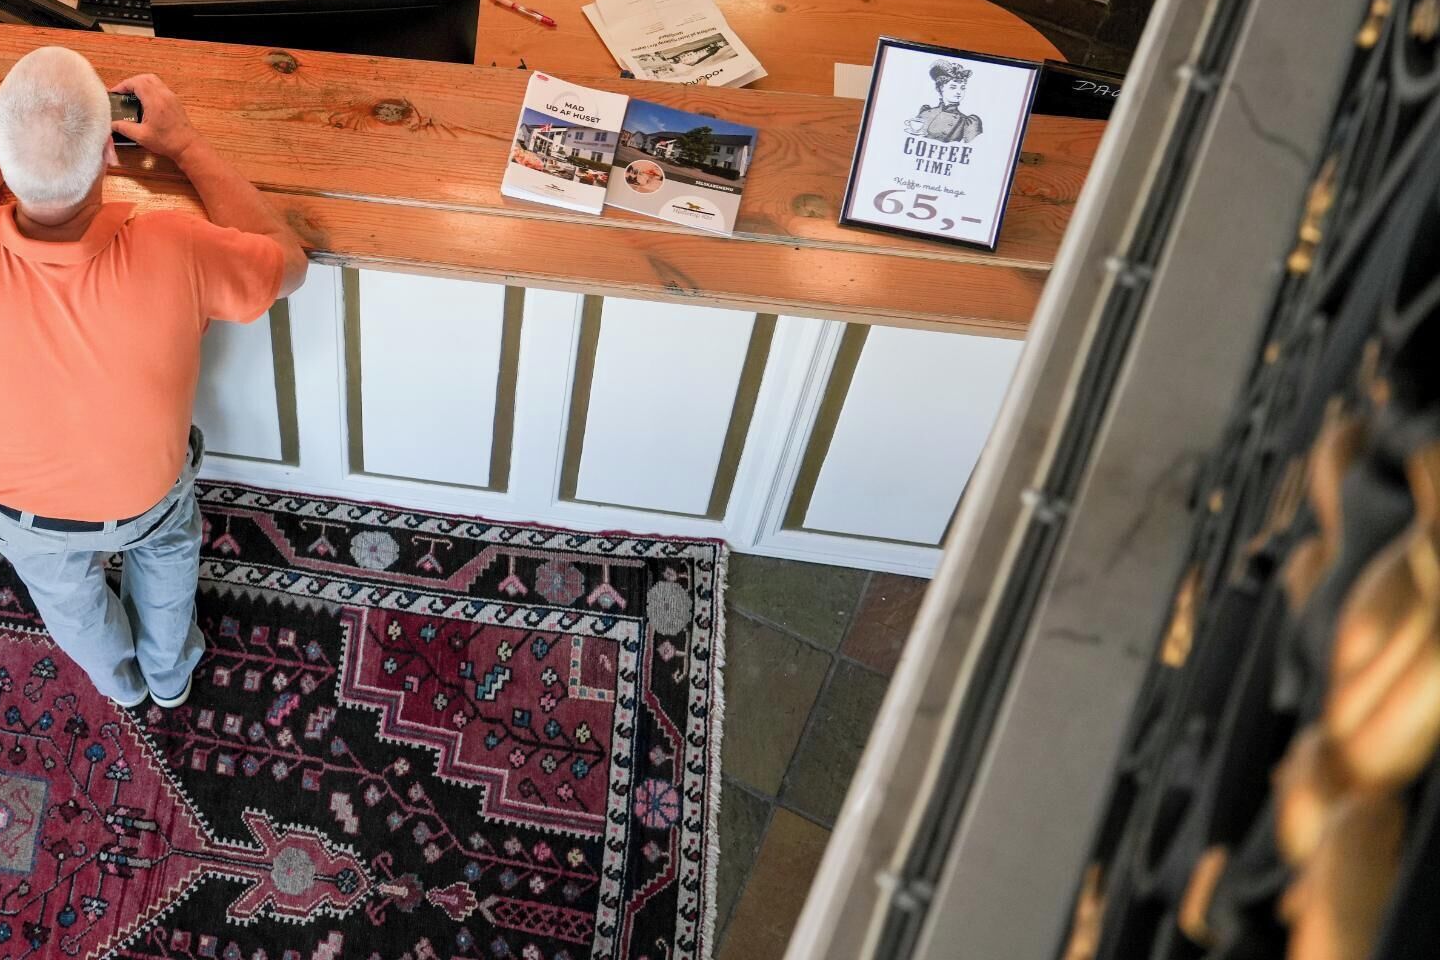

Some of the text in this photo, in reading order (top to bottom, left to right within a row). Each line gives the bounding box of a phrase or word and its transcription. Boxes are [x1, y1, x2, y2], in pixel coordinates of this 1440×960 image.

[546, 103, 558, 112] UD
[573, 112, 601, 124] HUSET
[564, 101, 585, 112] MAD
[903, 136, 973, 165] COFFEE
[915, 158, 953, 177] TIME
[893, 176, 967, 197] Kaffe med kage
[873, 189, 982, 231] 65,-
